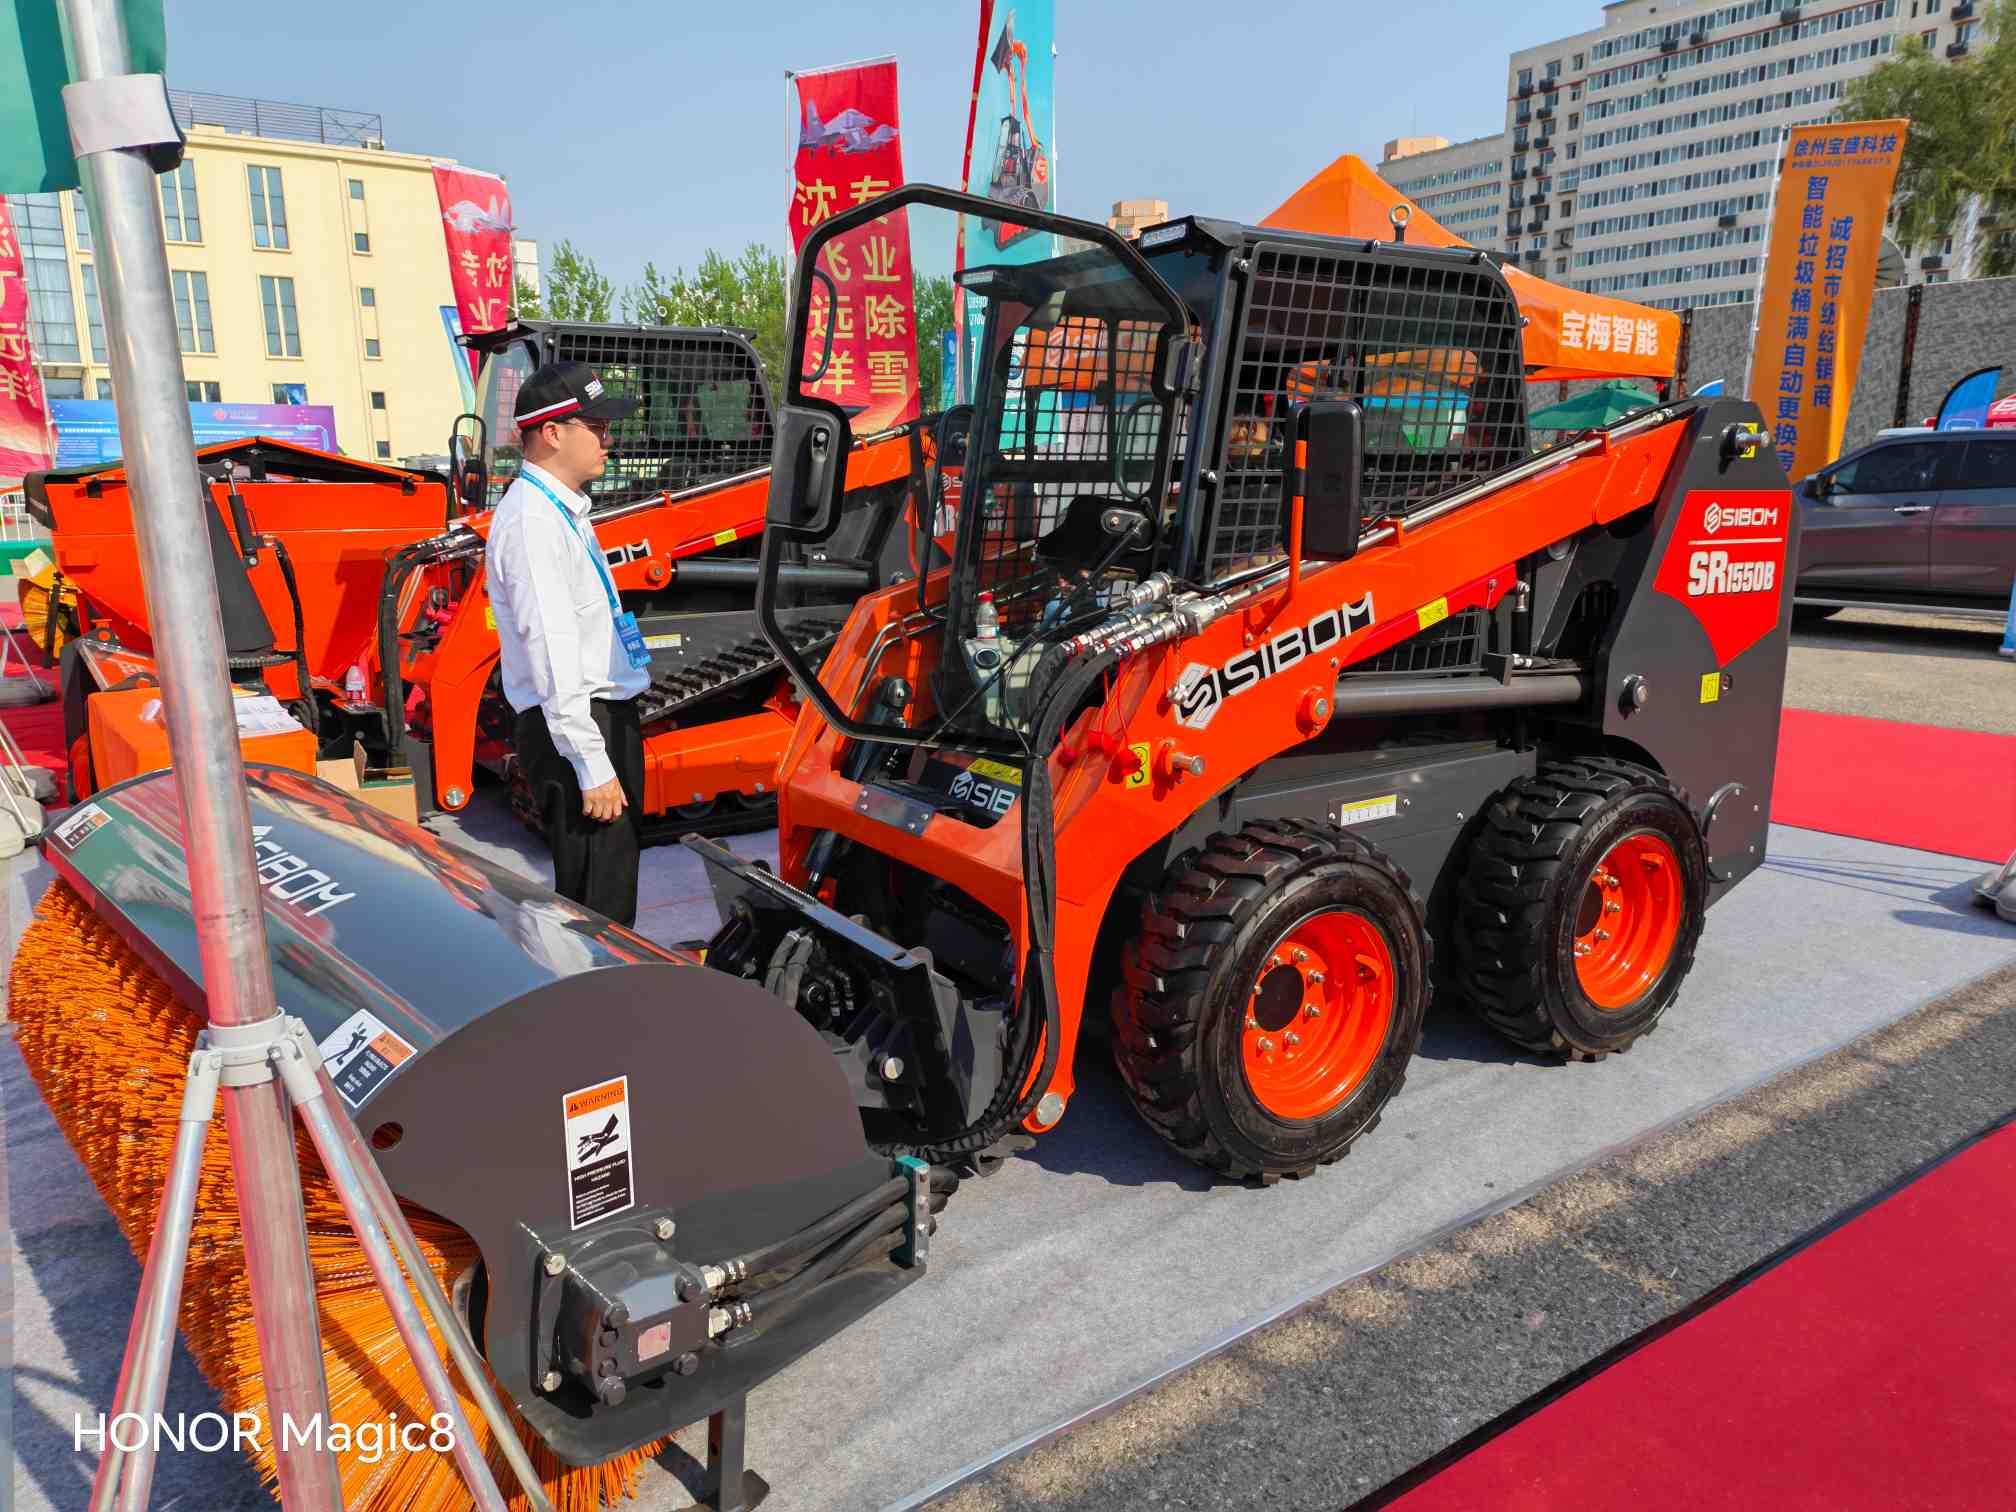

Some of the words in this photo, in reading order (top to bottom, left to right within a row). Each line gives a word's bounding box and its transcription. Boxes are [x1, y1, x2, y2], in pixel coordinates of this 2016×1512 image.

[1561, 310, 1658, 356] 宝梅智能
[1720, 507, 1778, 527] SIBOM
[1688, 550, 1776, 597] SR1550B
[1224, 591, 1376, 696] SIBOM
